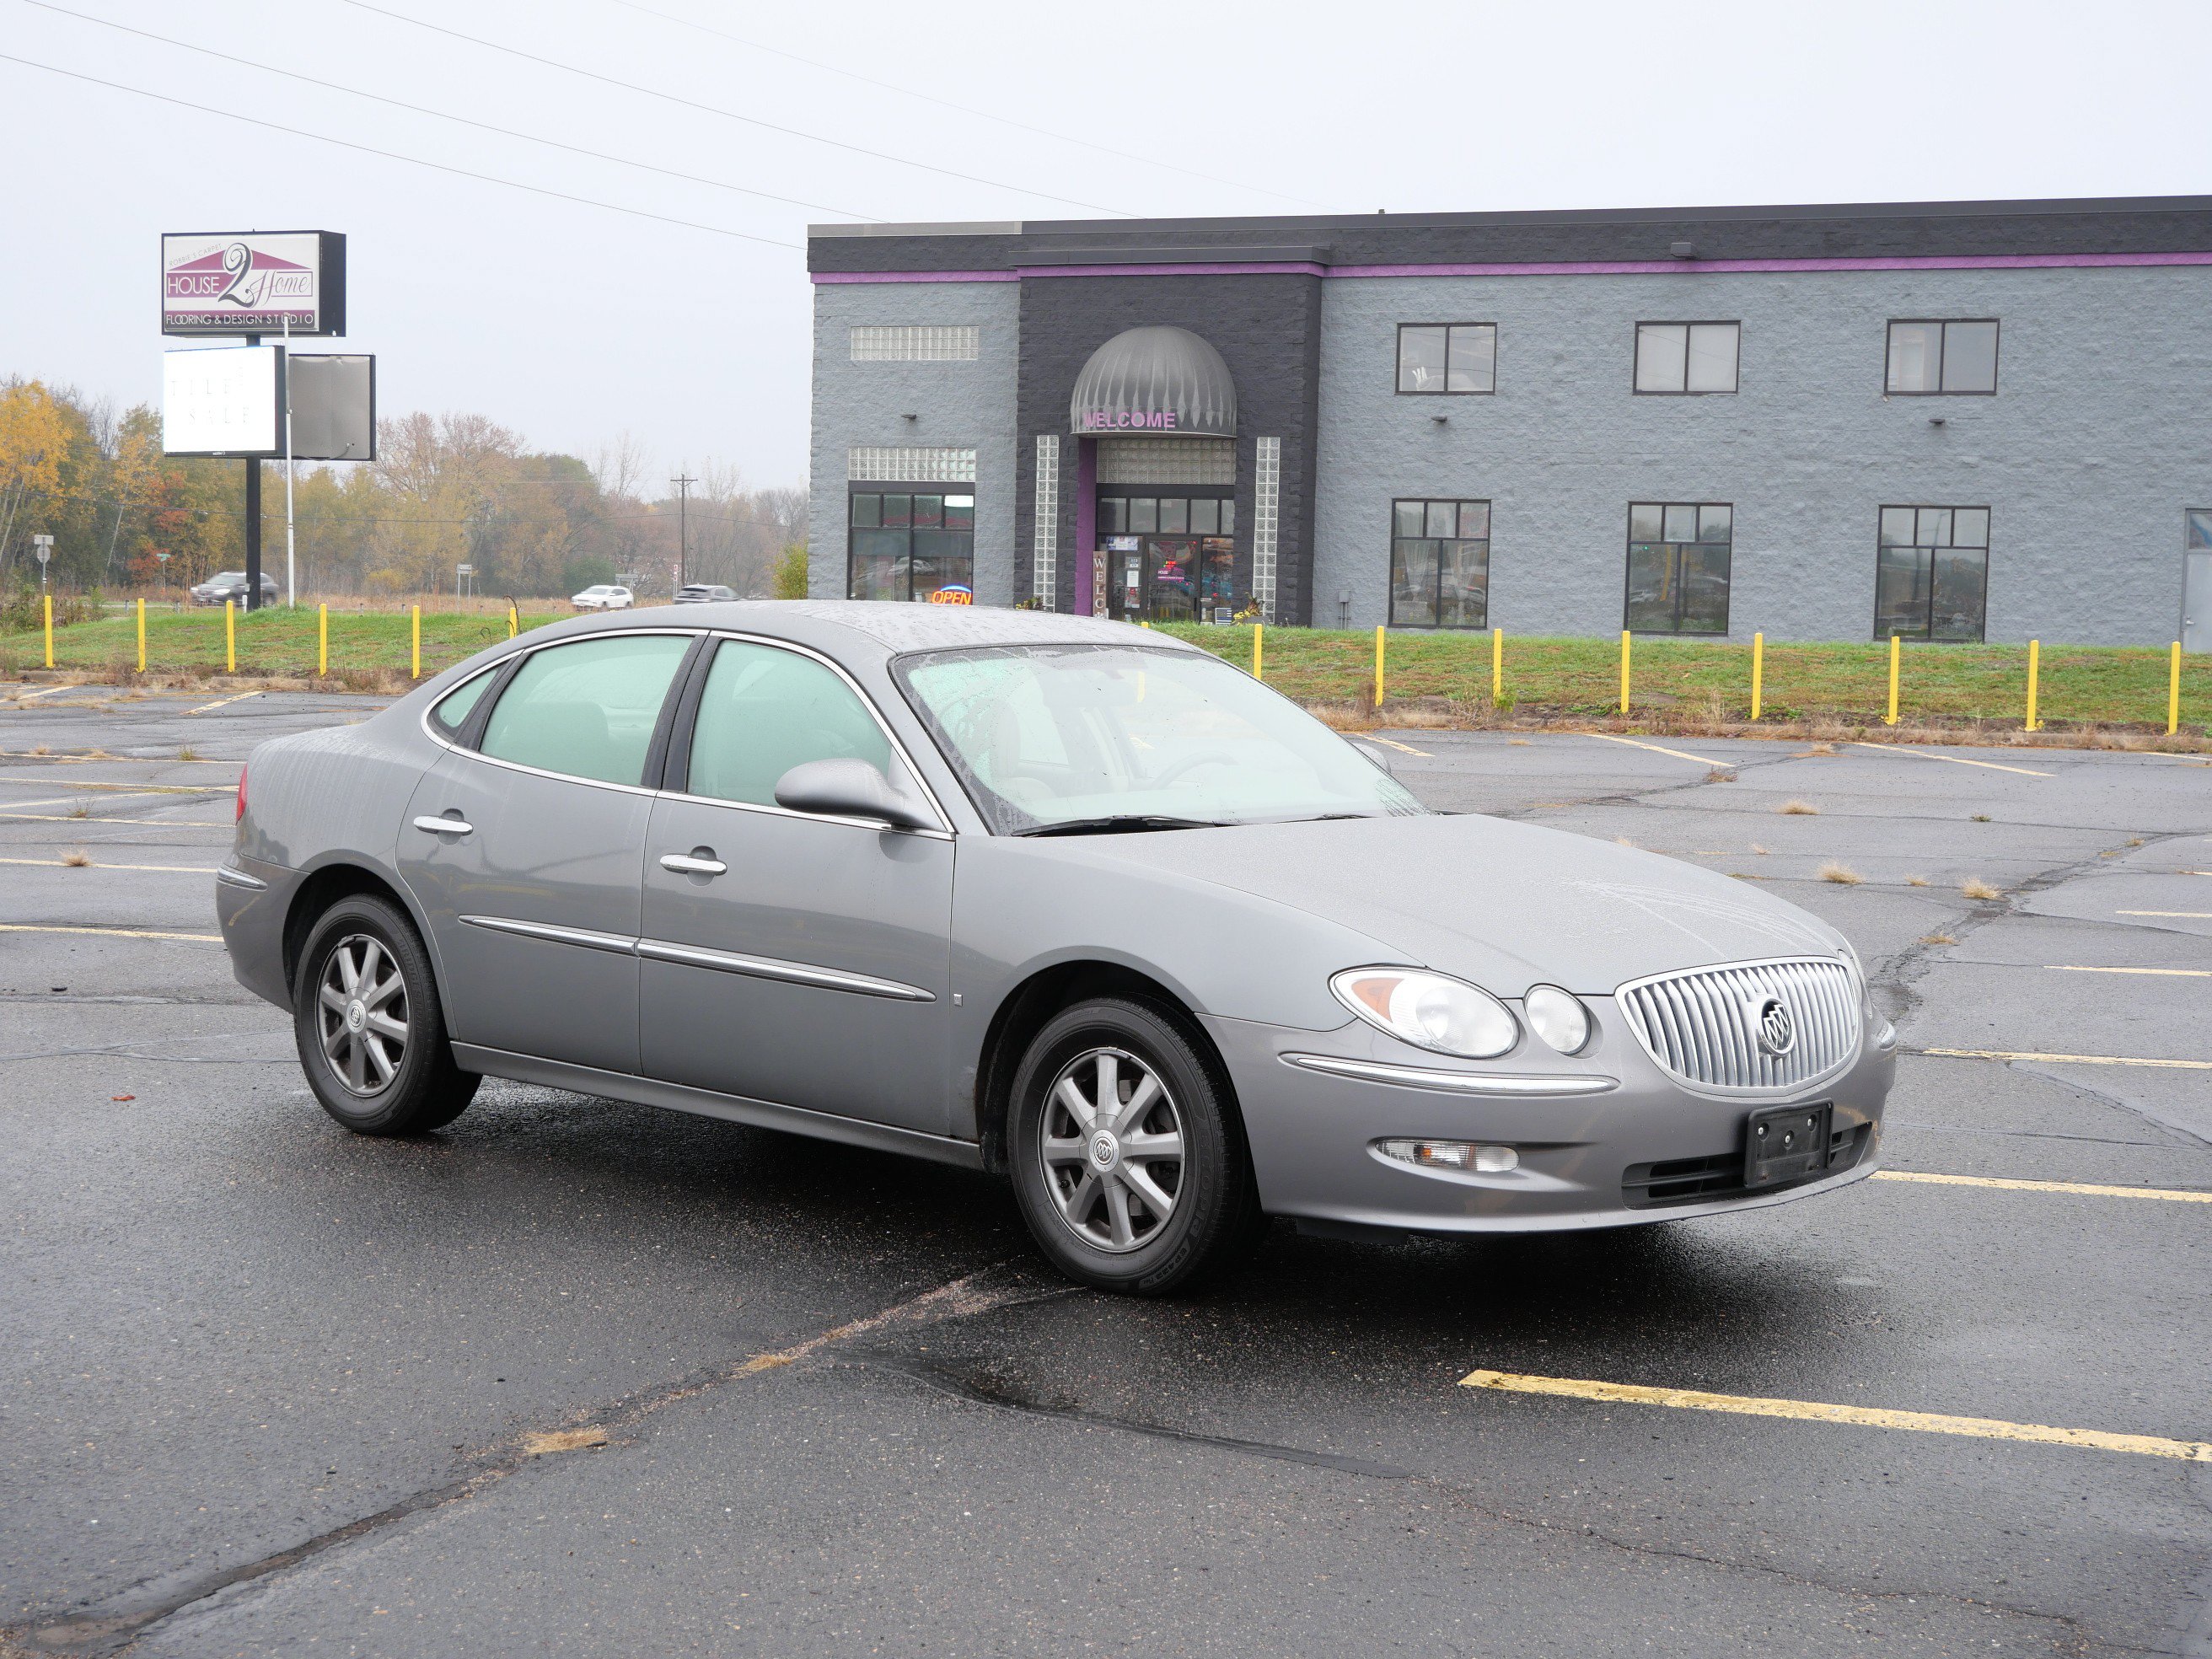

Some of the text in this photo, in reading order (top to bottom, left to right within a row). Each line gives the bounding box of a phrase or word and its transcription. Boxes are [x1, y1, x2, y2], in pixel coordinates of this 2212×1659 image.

[197, 244, 223, 257] CARPET
[168, 276, 220, 295] HOUSE
[245, 270, 310, 309] Home
[166, 313, 314, 325] FLOORING & DESIGN STUDIO
[1082, 411, 1176, 428] WELCOME
[1093, 558, 1106, 613] WELC
[932, 590, 972, 605] OPEN
